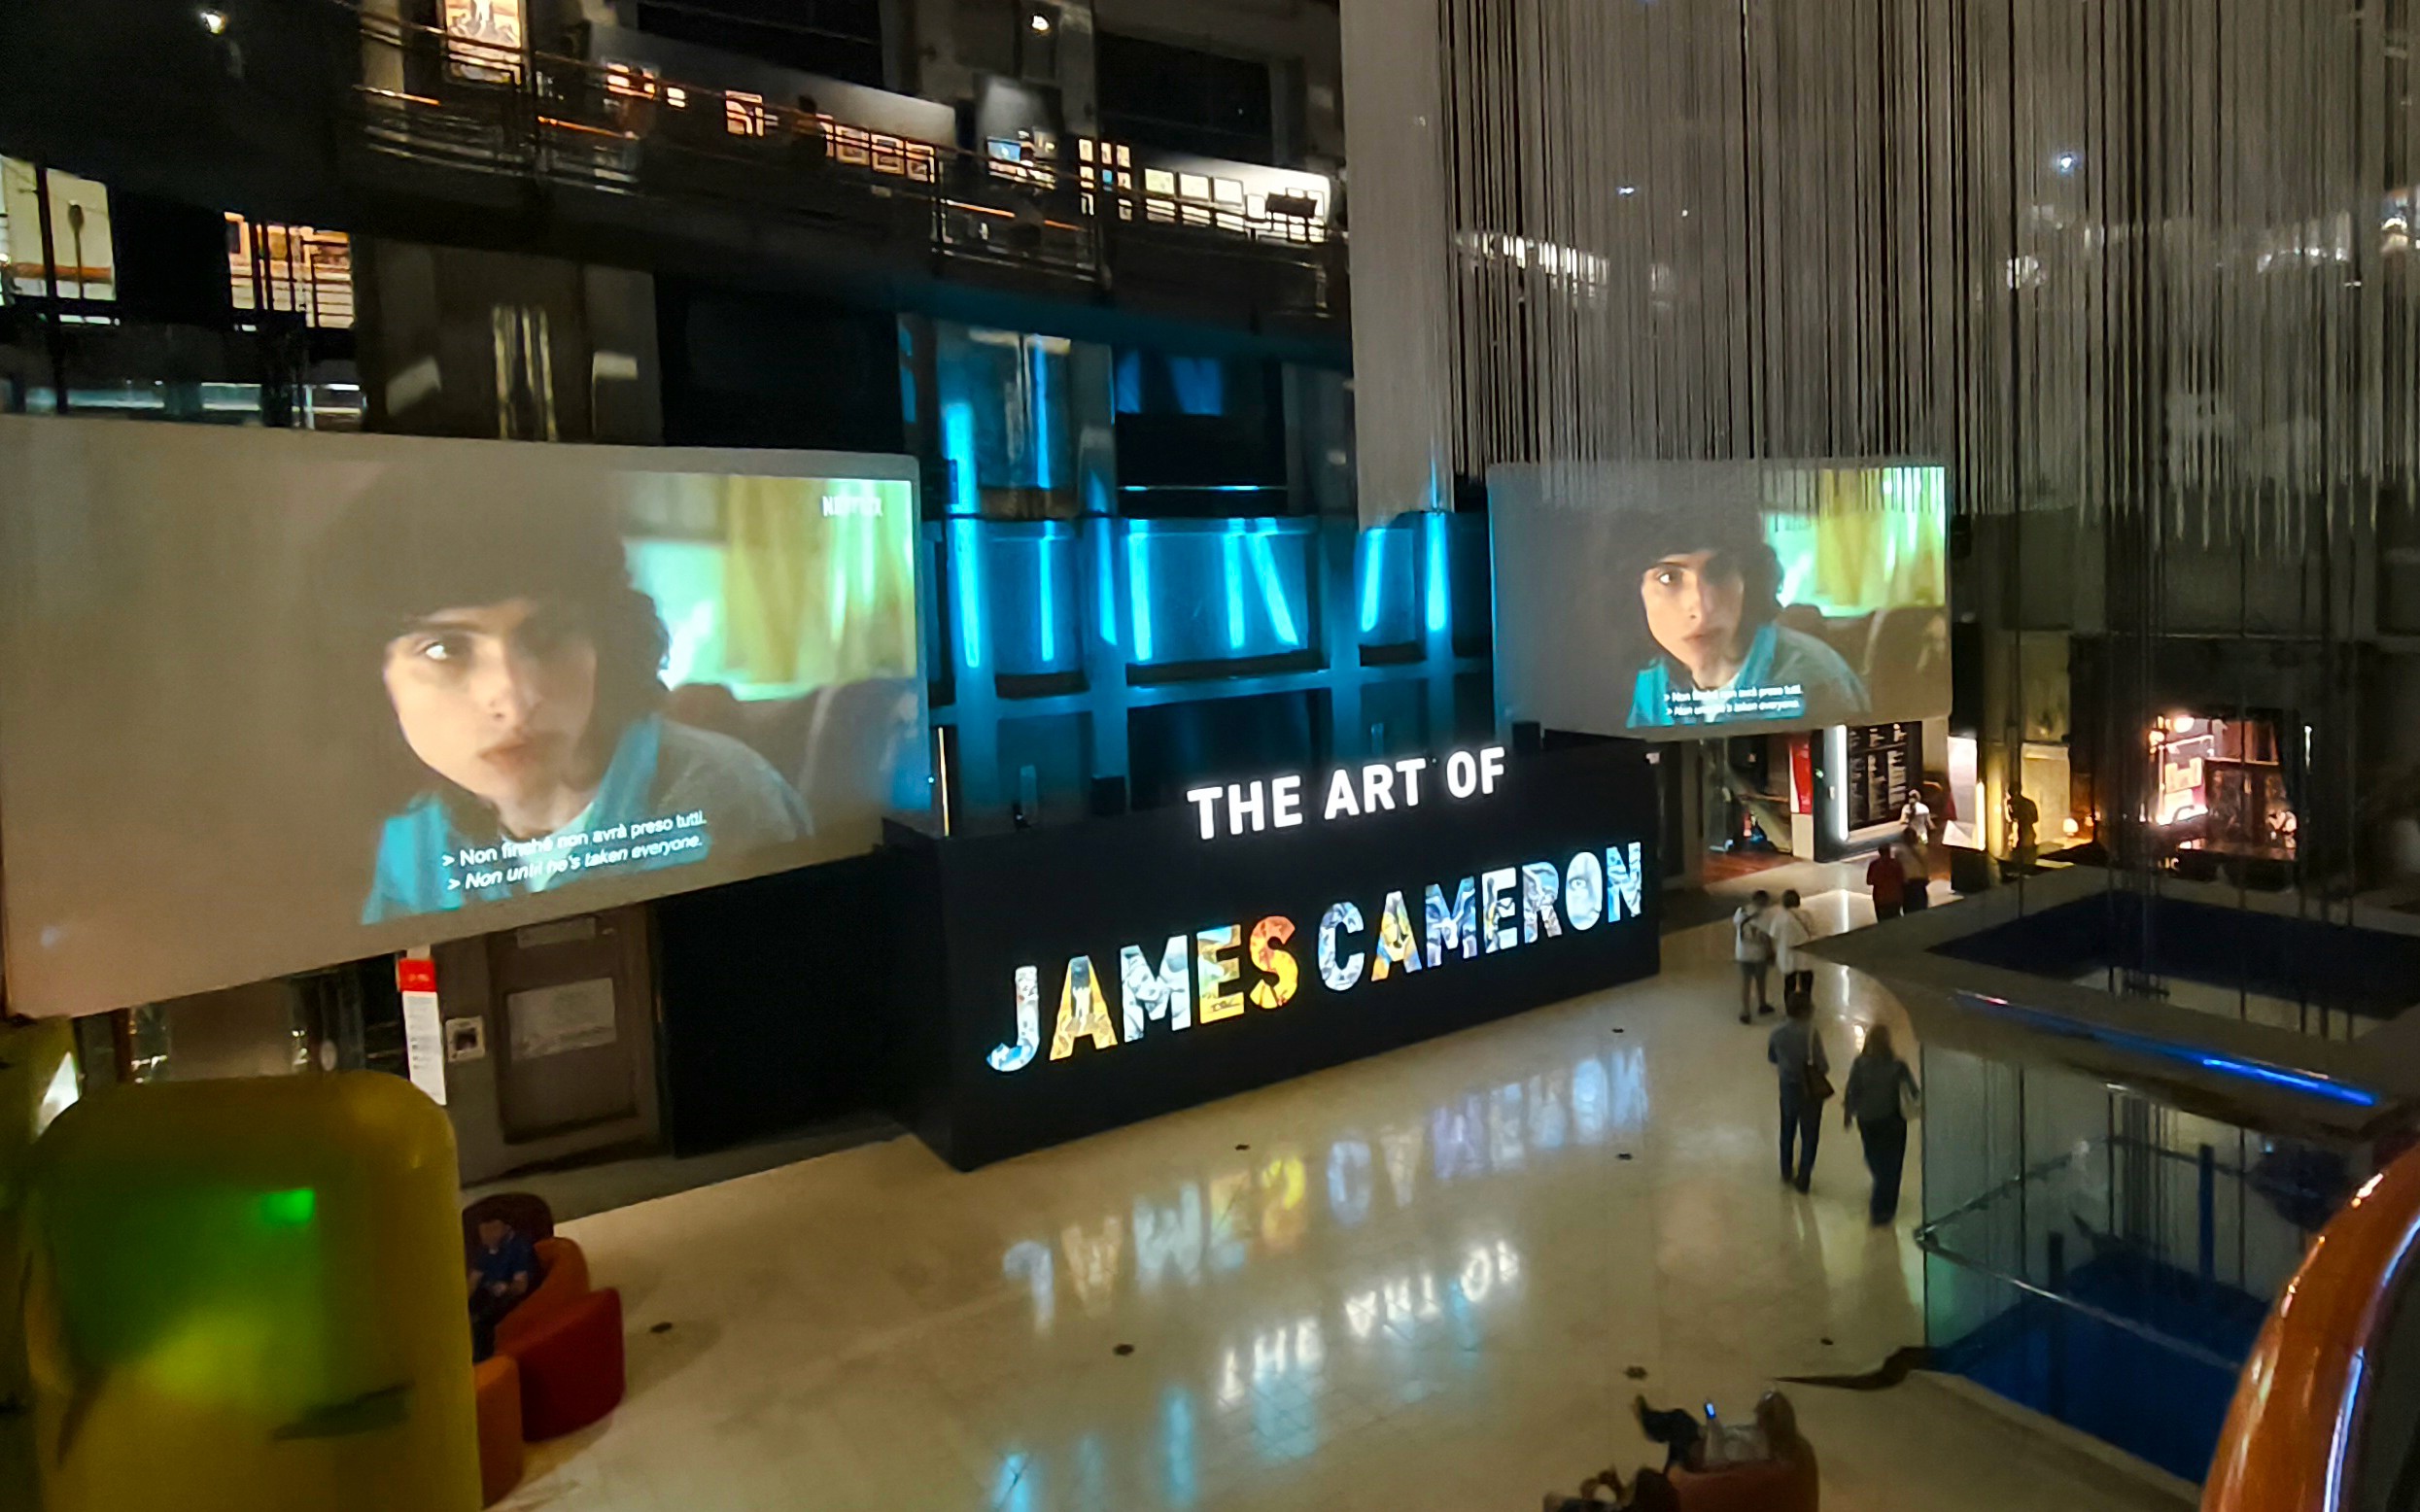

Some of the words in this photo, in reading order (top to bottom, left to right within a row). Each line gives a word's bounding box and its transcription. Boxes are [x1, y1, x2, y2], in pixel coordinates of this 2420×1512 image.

[1187, 775, 1303, 841] THE
[1324, 758, 1427, 820] ART
[1446, 747, 1505, 799] OF
[460, 847, 498, 869] Non
[557, 832, 589, 849] non
[631, 817, 674, 840] preso
[465, 869, 502, 890] Non
[584, 845, 628, 868] taken
[985, 914, 1299, 1073] JAMES
[1316, 841, 1642, 992] CAMERON
